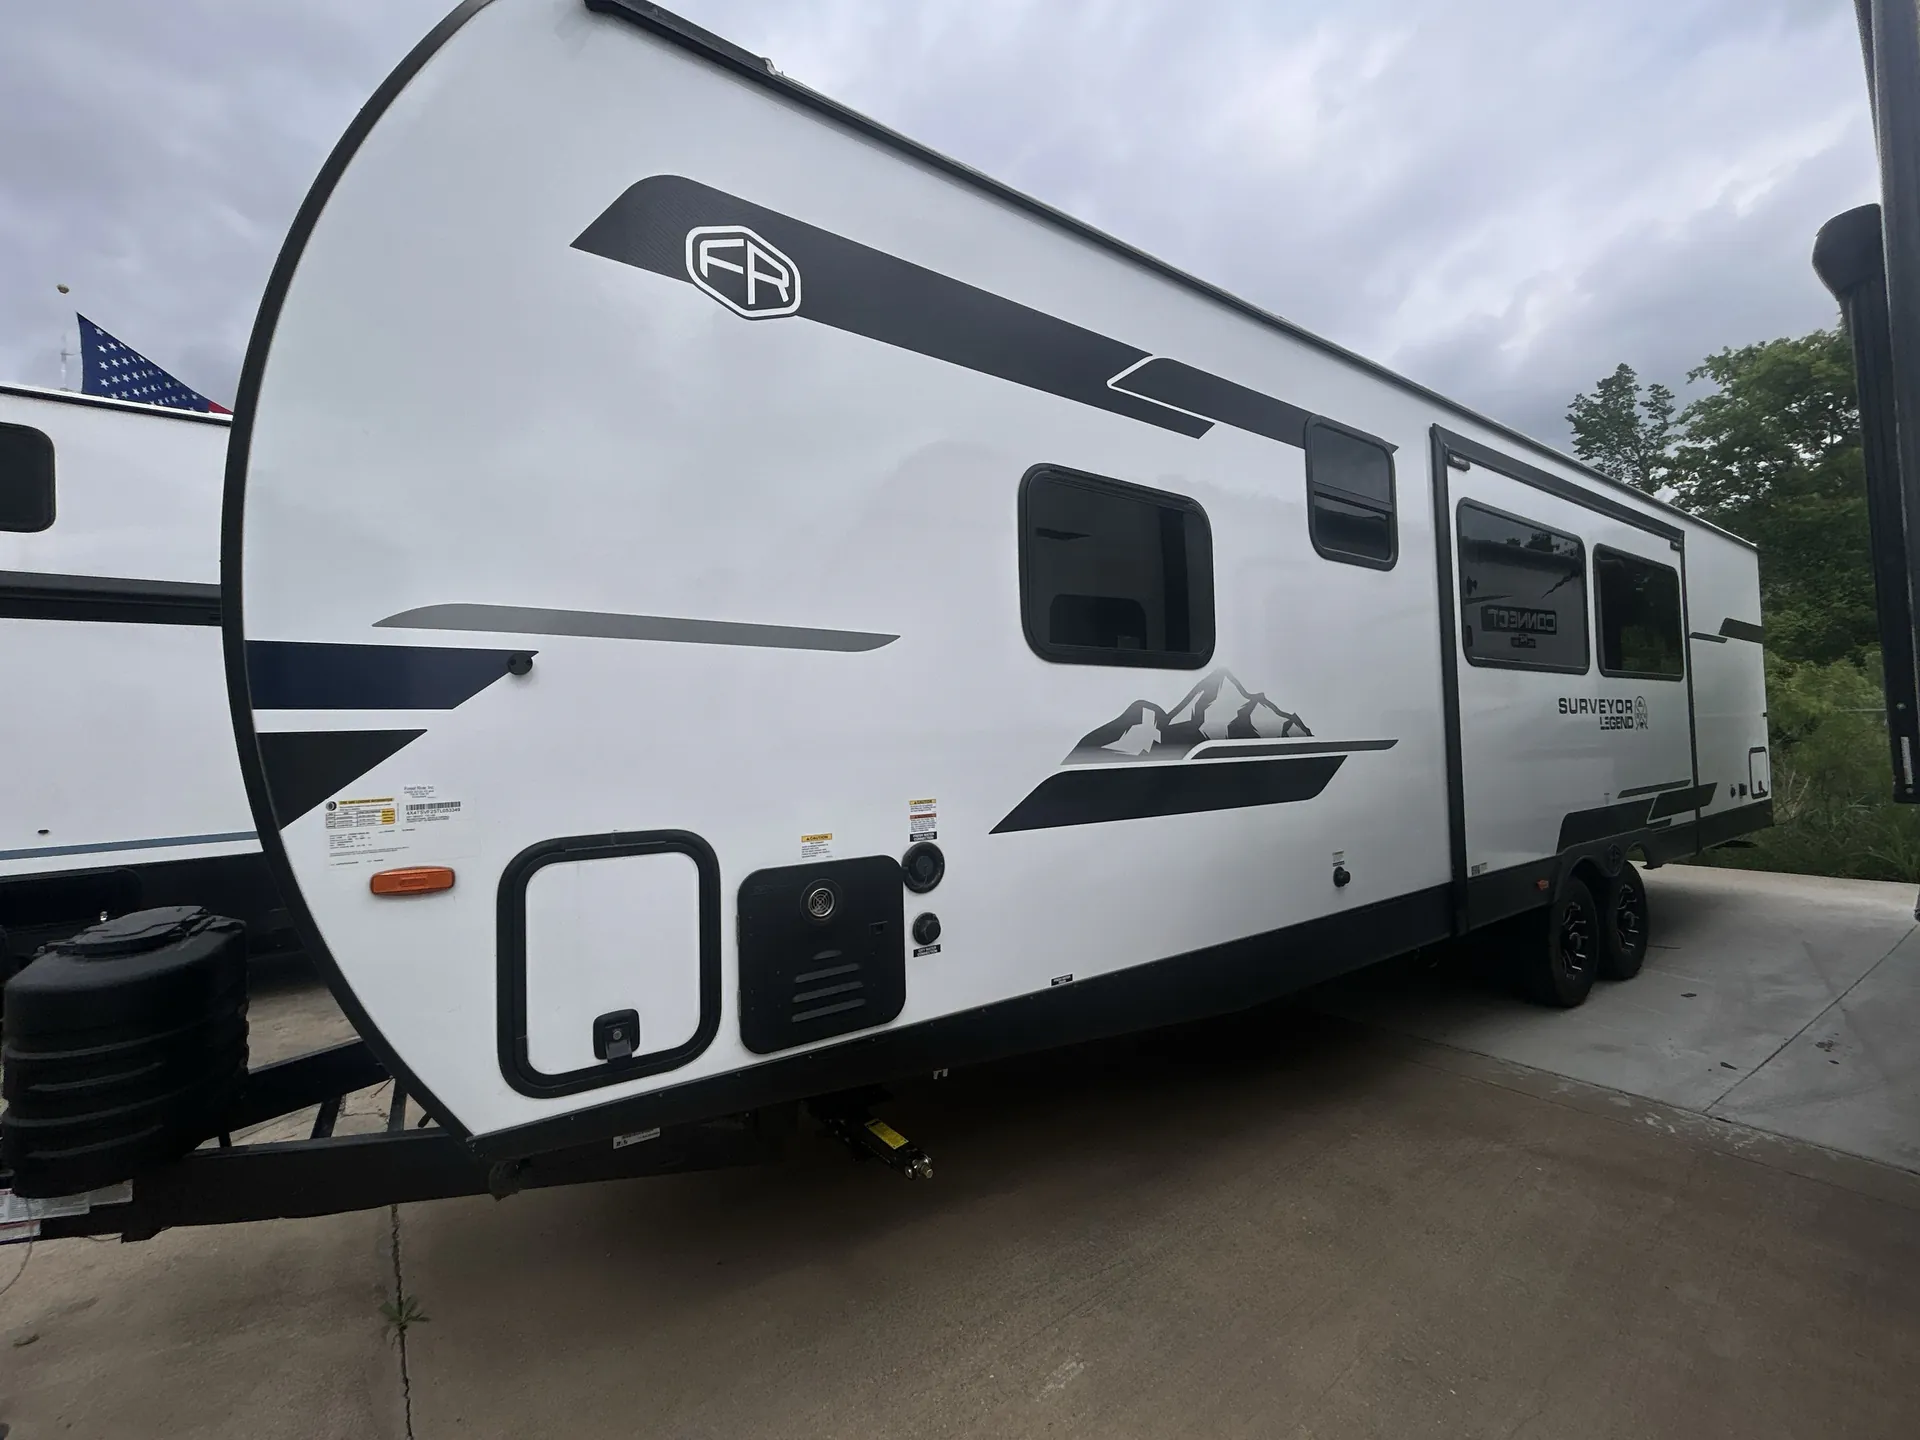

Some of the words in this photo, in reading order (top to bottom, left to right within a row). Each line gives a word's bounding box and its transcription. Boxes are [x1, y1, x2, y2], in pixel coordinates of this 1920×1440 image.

[699, 238, 790, 305] FR
[1558, 697, 1633, 715] SURVEYOR
[1599, 715, 1634, 730] LEGEND
